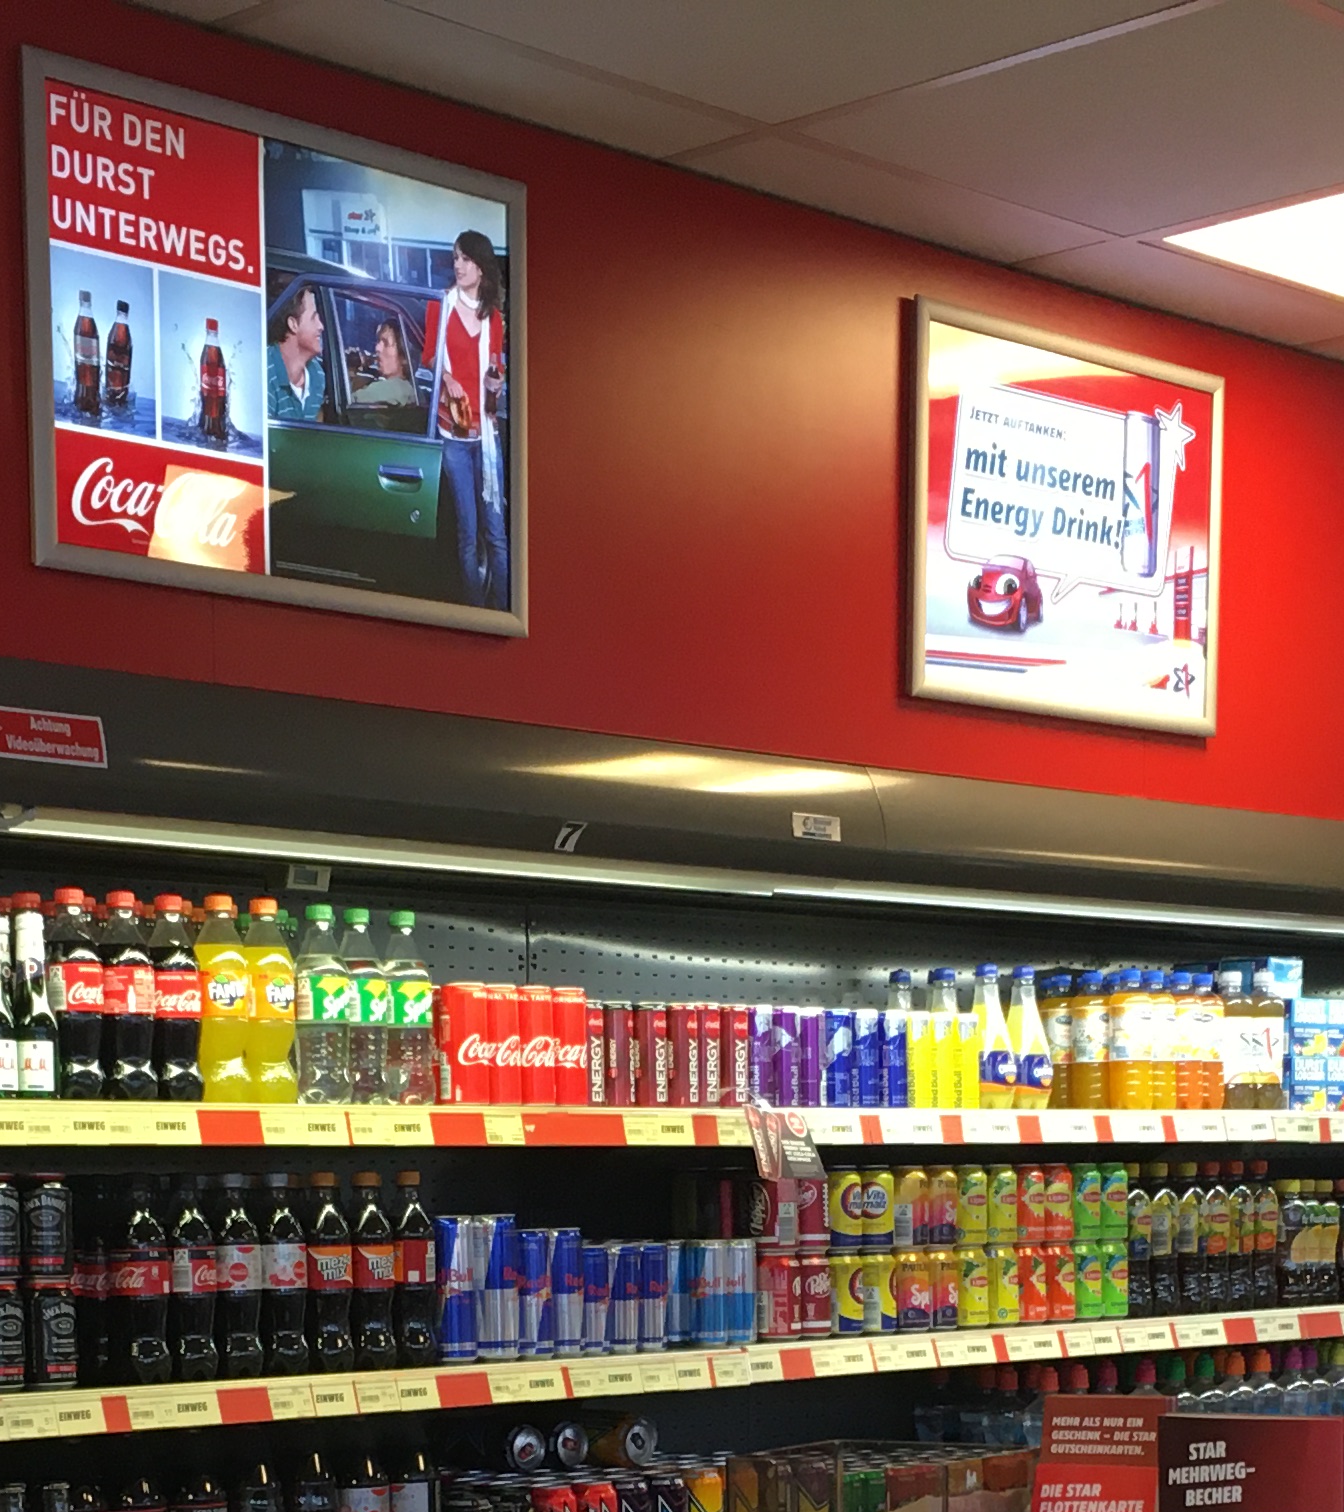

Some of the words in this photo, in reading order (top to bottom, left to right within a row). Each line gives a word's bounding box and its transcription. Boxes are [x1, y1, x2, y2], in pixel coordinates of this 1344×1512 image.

[49, 91, 112, 141] FÜR
[124, 114, 184, 159] DEN
[51, 145, 154, 199] DURST
[51, 196, 254, 273] UNTERWEGS.
[970, 406, 999, 424] JETZT
[965, 443, 1006, 478] mit
[1016, 457, 1116, 500] unserem
[961, 486, 1044, 538] Energy
[1052, 507, 1121, 549] Drink!
[30, 716, 71, 737] Achtung
[6, 734, 99, 761] Videoüberwachung
[559, 822, 583, 848] 7
[592, 1035, 603, 1102] ENERGY
[707, 1038, 717, 1102] ENERGY
[736, 1037, 747, 1102] ENERGY
[1052, 1417, 1080, 1426] MEHR
[1083, 1417, 1100, 1426] ALS
[1103, 1418, 1124, 1427] NUR
[1127, 1418, 1144, 1427] EIN
[1051, 1444, 1145, 1455] GUTSCHEINKARTEN.
[1052, 1431, 1100, 1440] GESCHENK
[1114, 1432, 1129, 1441] DIE
[1133, 1432, 1156, 1442] STAR
[1188, 1441, 1226, 1460] STAR
[1168, 1462, 1256, 1485] MEHRWEG-
[1041, 1484, 1063, 1497] DIE
[1066, 1484, 1101, 1497] STAR
[1185, 1485, 1242, 1506] BECHER
